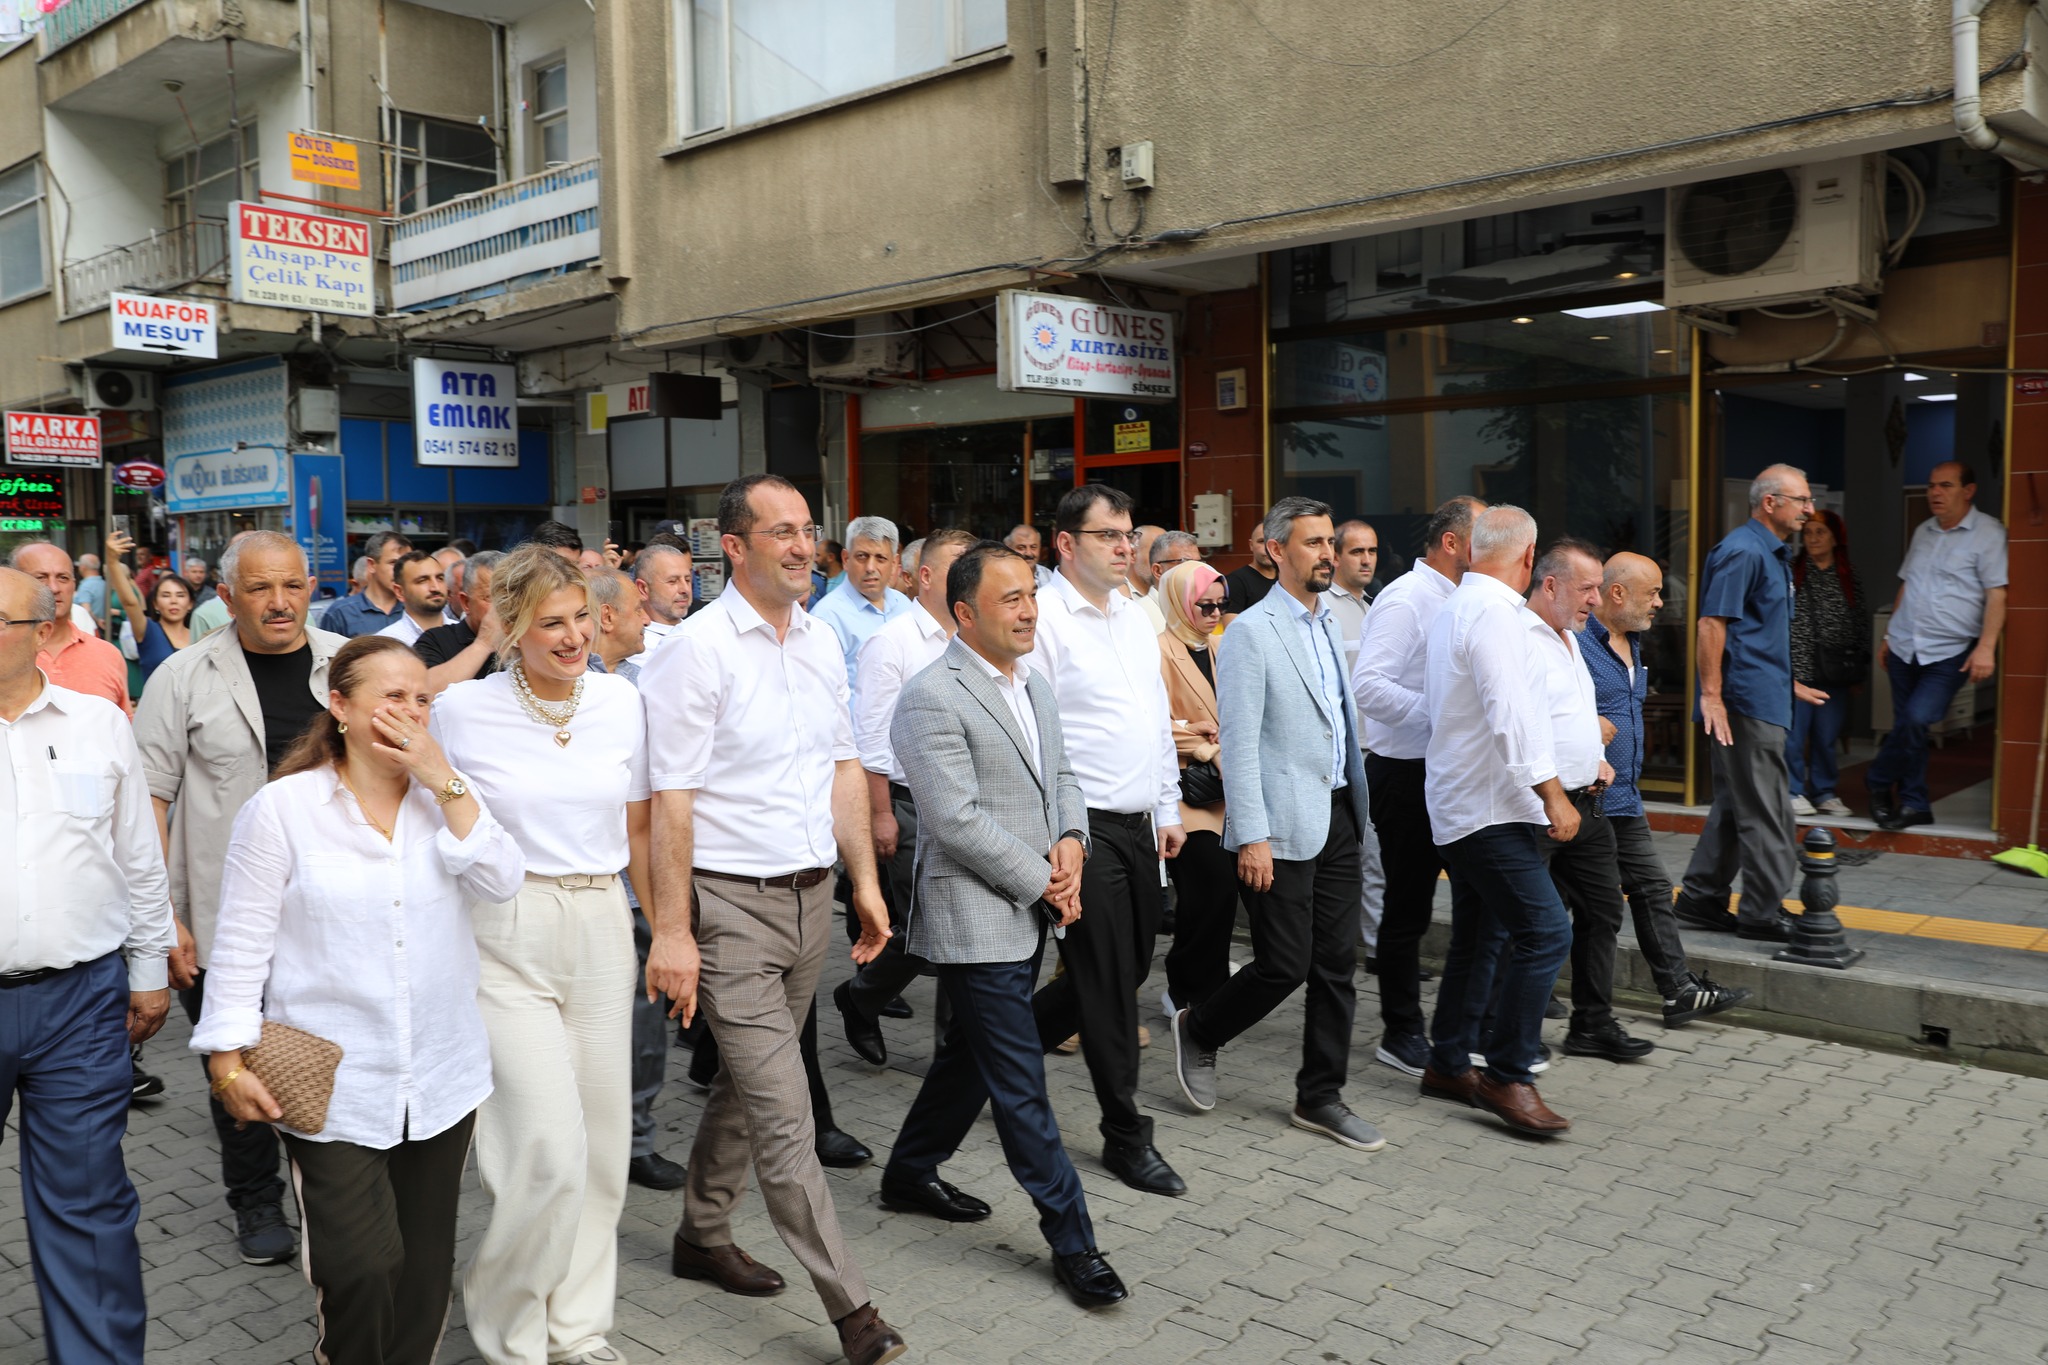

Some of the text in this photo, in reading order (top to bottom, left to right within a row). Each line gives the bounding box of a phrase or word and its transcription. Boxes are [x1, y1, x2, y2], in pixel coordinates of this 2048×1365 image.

[294, 136, 334, 154] ONUR
[244, 210, 366, 253] TEKSEN
[248, 264, 364, 297] Çelik Kapı
[117, 299, 208, 324] KUAFÖR
[124, 321, 204, 343] MESUT
[1070, 306, 1165, 346] GÜNEŞ
[1070, 339, 1169, 361] KIRTASİYE
[441, 371, 496, 397] ATA
[9, 415, 97, 438] MARKA
[428, 403, 511, 430] EMLAK
[10, 434, 98, 449] BİLGİSAYAR
[424, 439, 516, 457] 0541 574 62 13
[0, 477, 55, 495] öfteci
